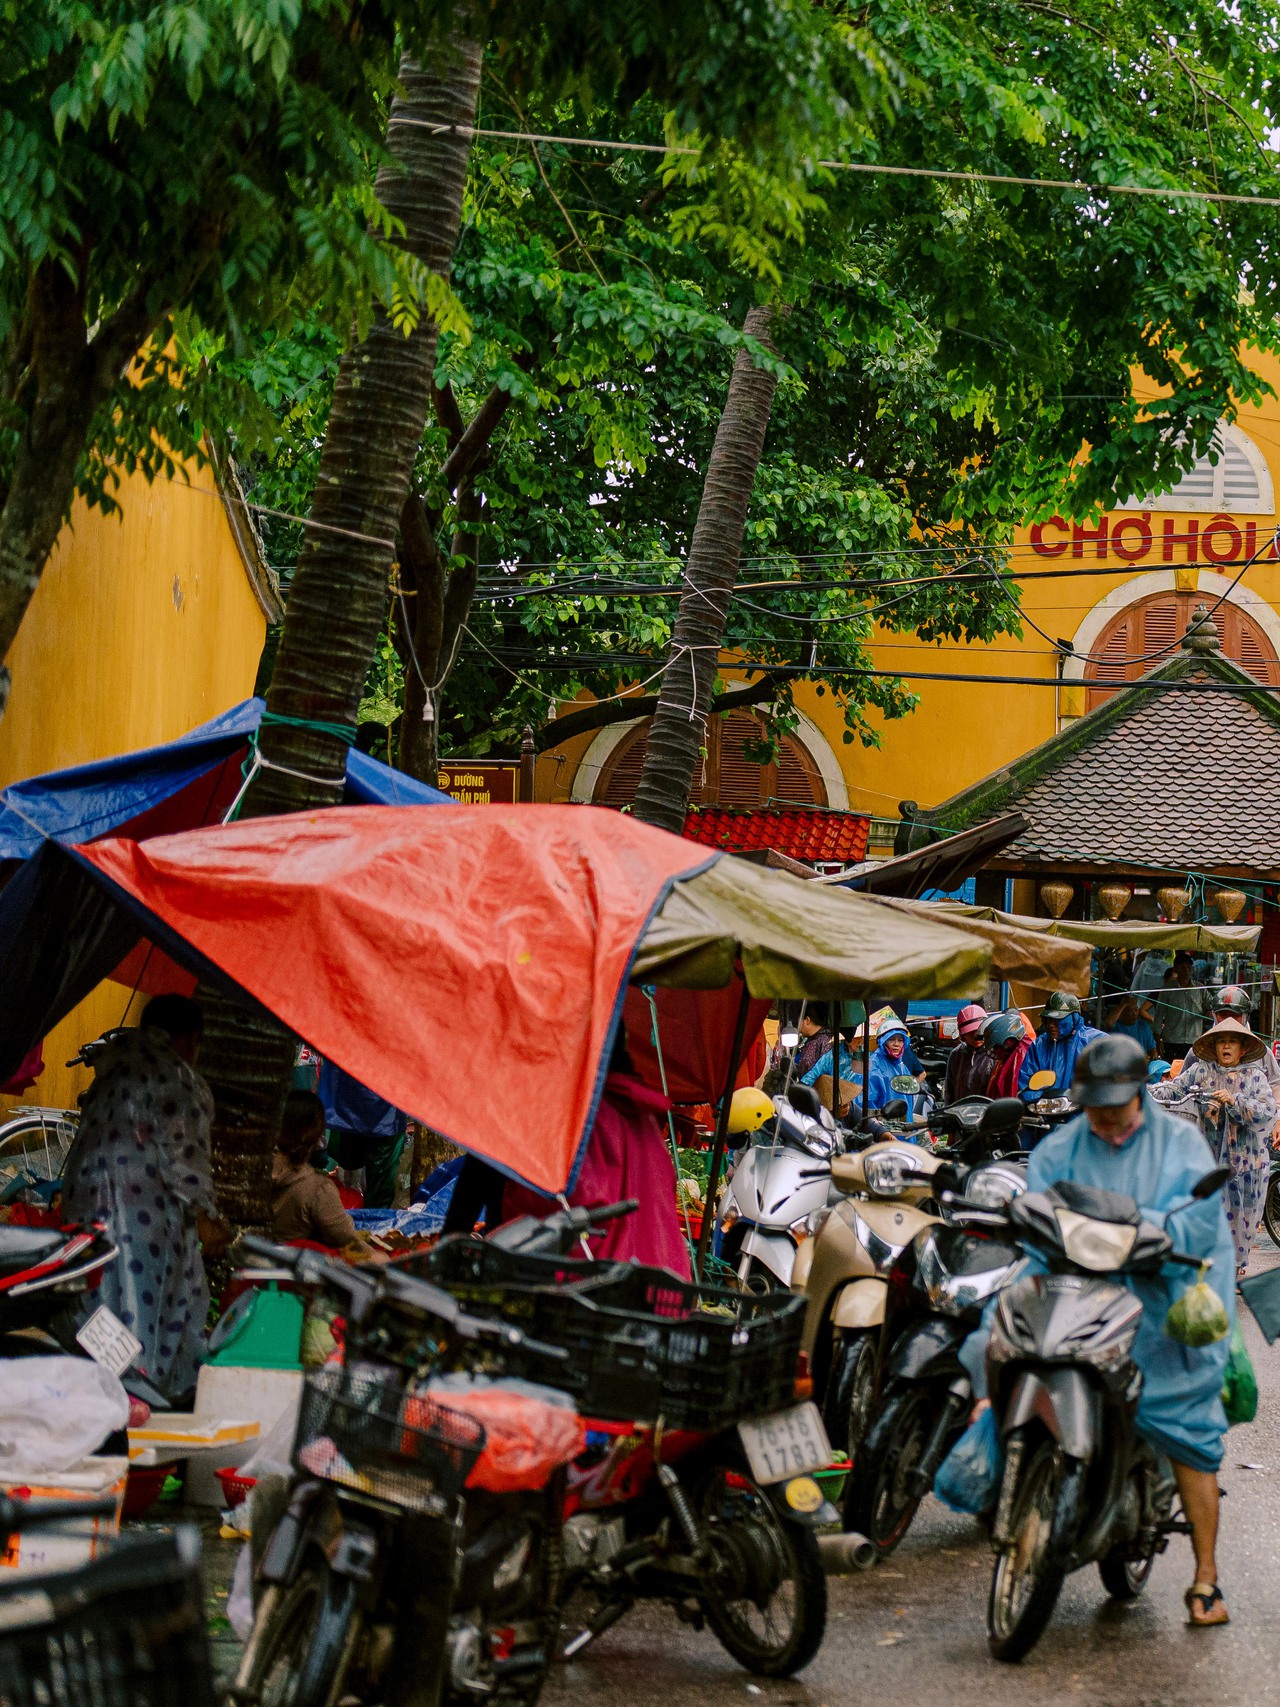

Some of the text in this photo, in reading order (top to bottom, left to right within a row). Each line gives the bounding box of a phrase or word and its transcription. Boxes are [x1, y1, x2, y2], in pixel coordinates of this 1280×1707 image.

[1030, 513, 1151, 567] CHỢ
[1163, 514, 1258, 572] HỘI
[454, 773, 484, 787] ĐƯỜNG
[473, 790, 490, 804] PHÚ
[763, 1440, 820, 1477] 1783
